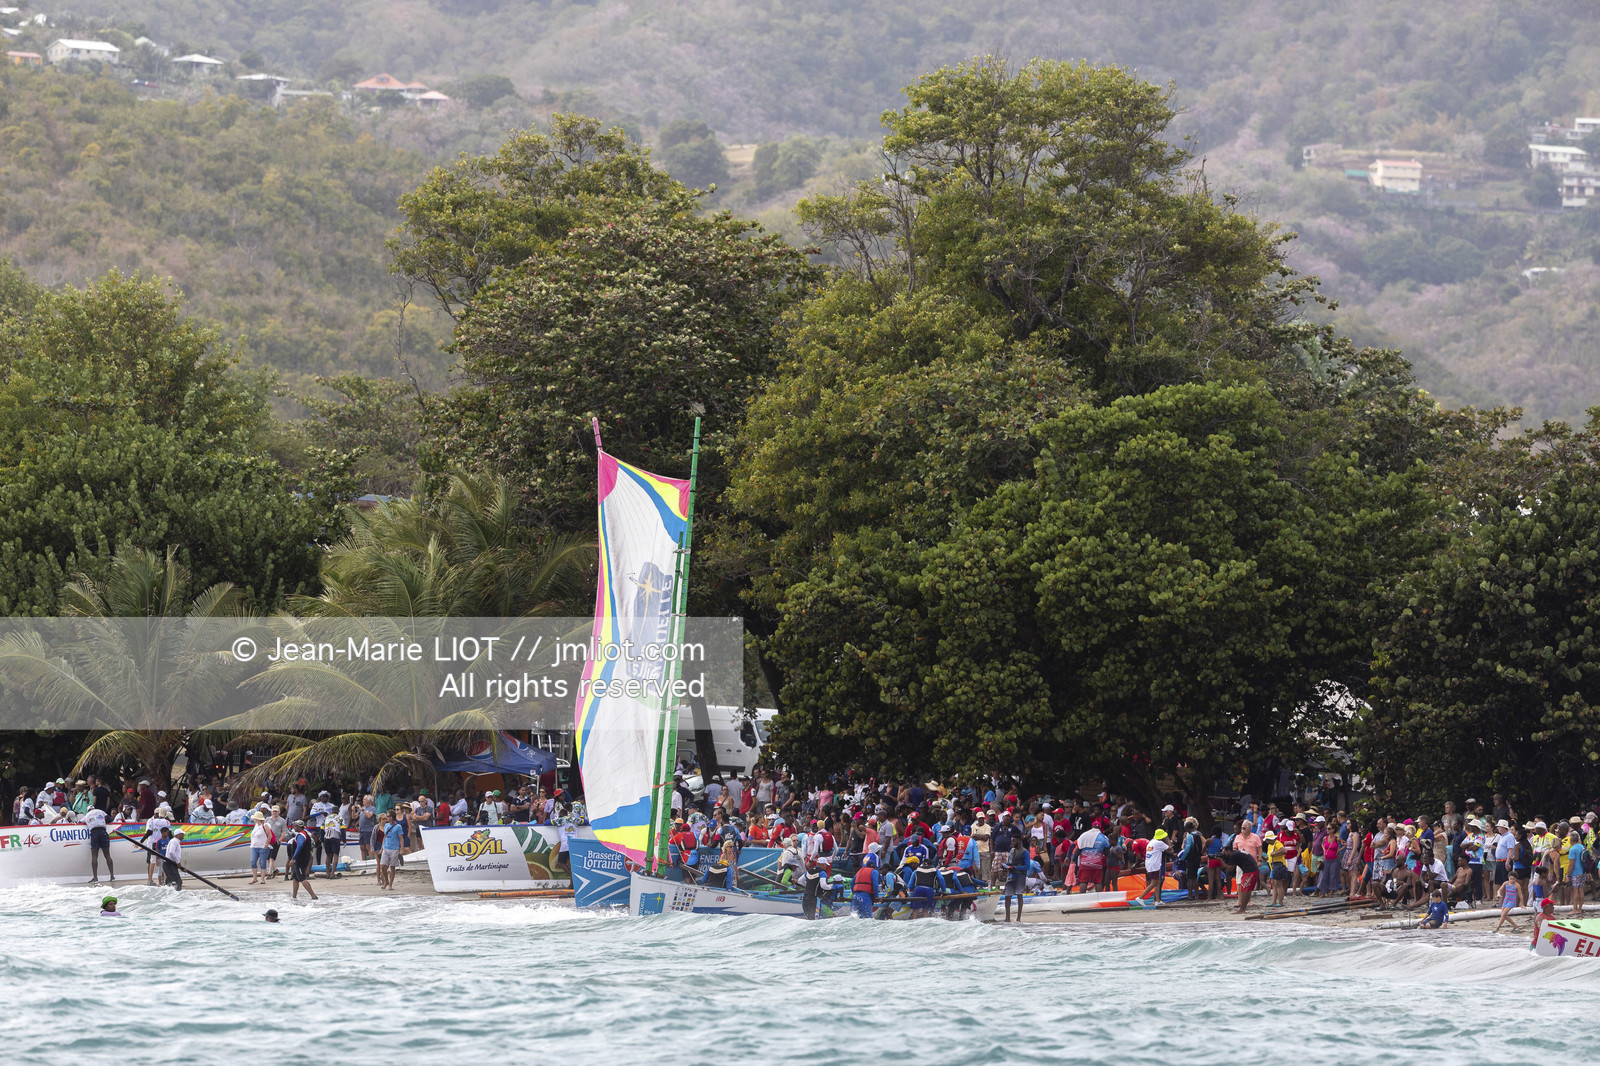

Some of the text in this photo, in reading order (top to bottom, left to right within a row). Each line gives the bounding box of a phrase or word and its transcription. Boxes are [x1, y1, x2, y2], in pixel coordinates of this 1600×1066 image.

[448, 838, 507, 861] ROYAL
[587, 850, 622, 860] Brasserie
[466, 863, 474, 871] de
[474, 863, 509, 872] Martinique
[583, 857, 623, 870] Lorraine
